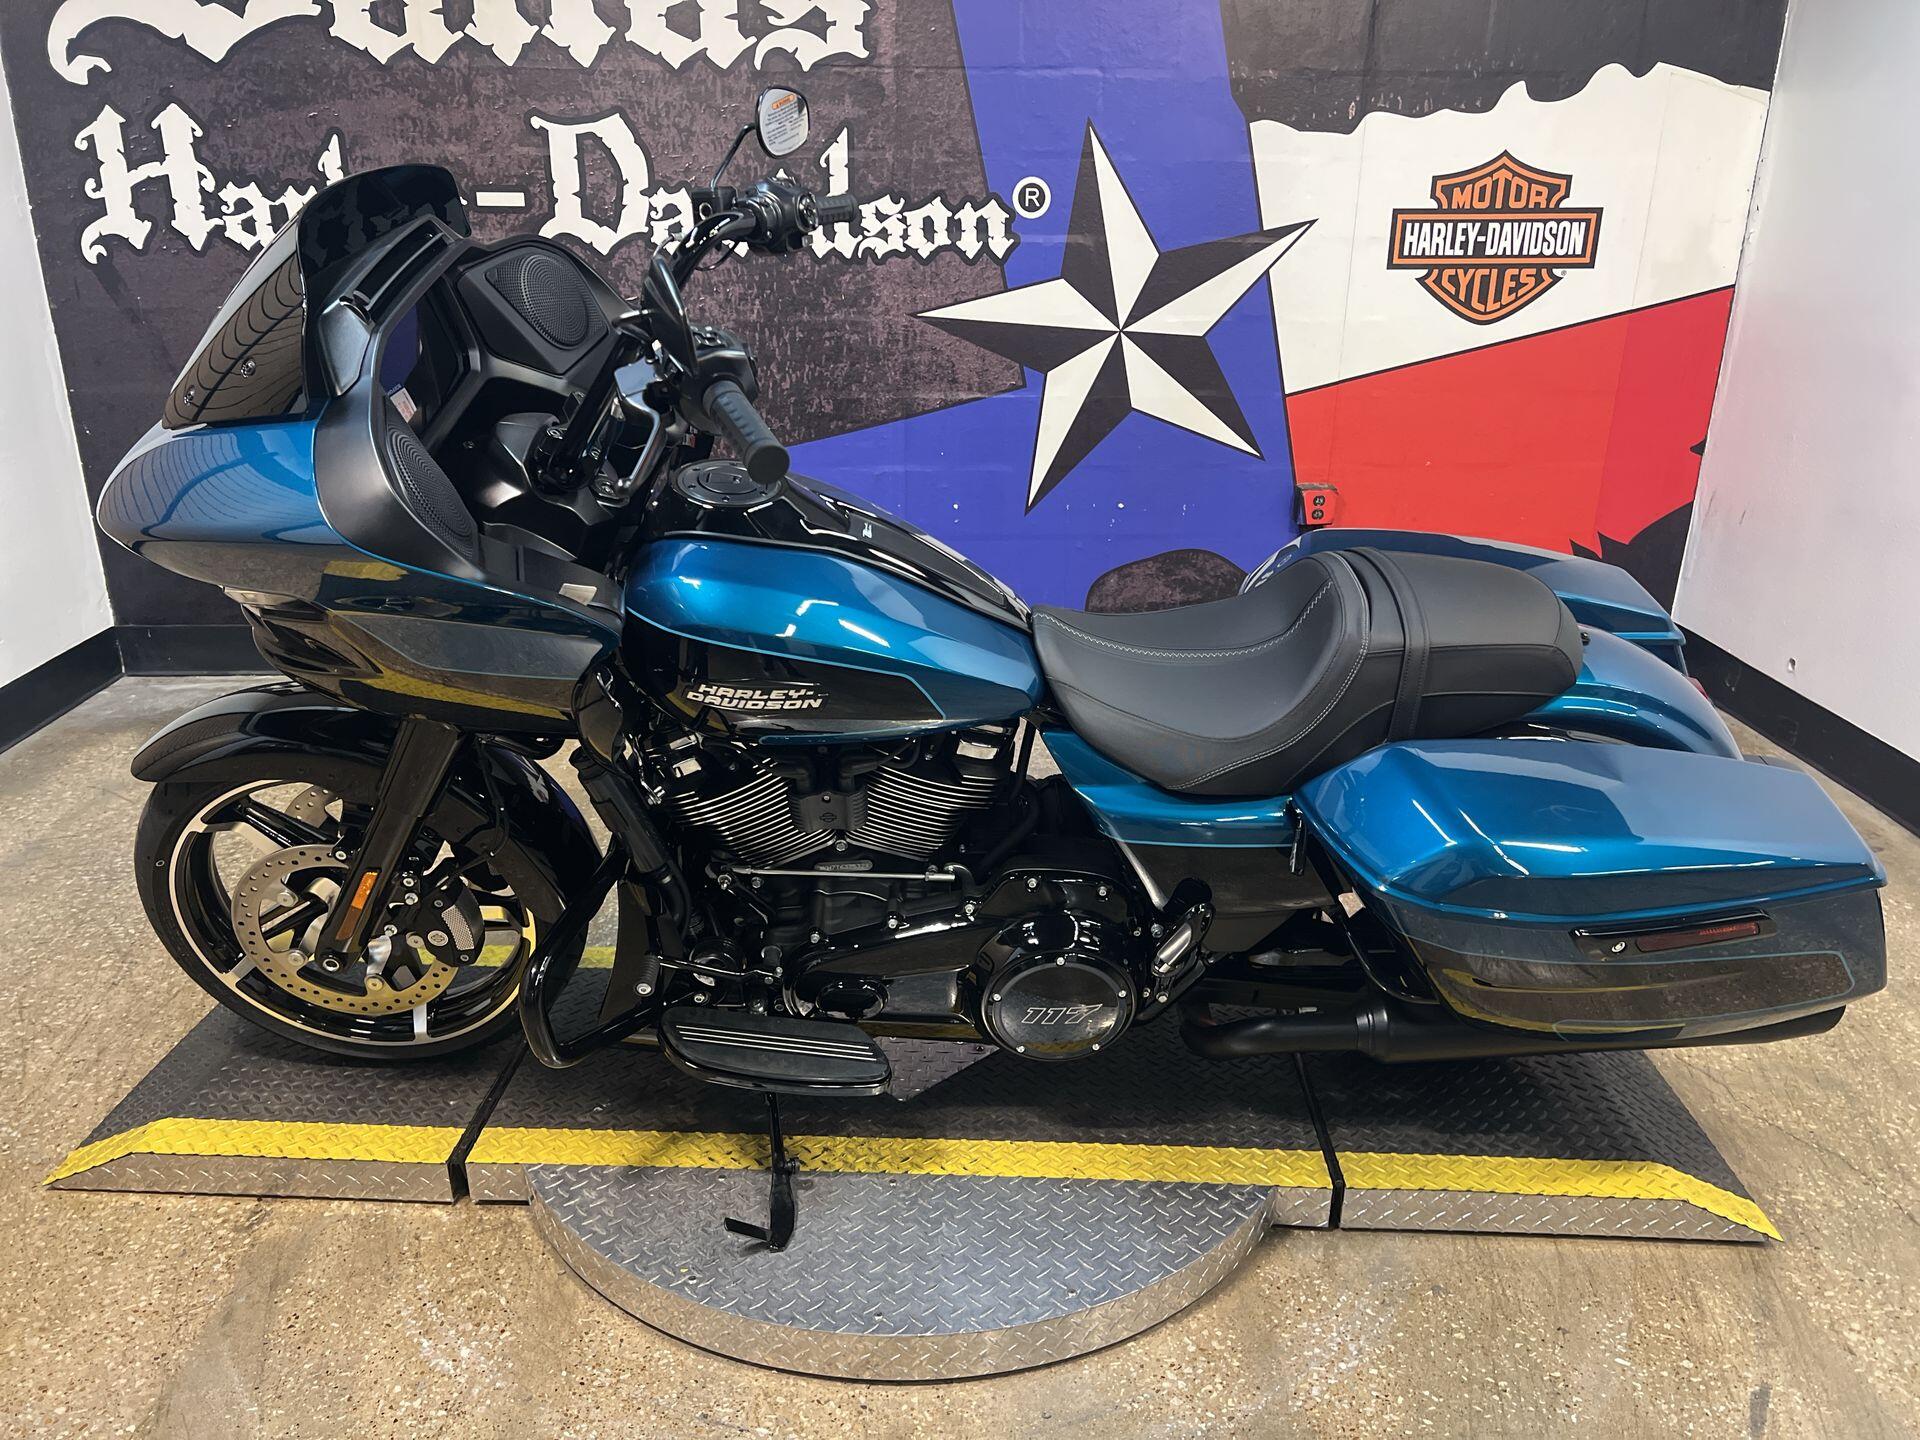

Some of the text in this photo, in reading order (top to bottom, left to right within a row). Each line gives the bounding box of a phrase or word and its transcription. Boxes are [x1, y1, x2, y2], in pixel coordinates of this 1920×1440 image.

[1451, 168, 1550, 209] MOTOR
[1403, 220, 1587, 256] HARLEY-DAVIDSON
[1441, 268, 1537, 313] CYCLES
[686, 691, 823, 710] DAVIDSON
[698, 683, 815, 700] HARLEY-
[1021, 1003, 1103, 1025] 117
